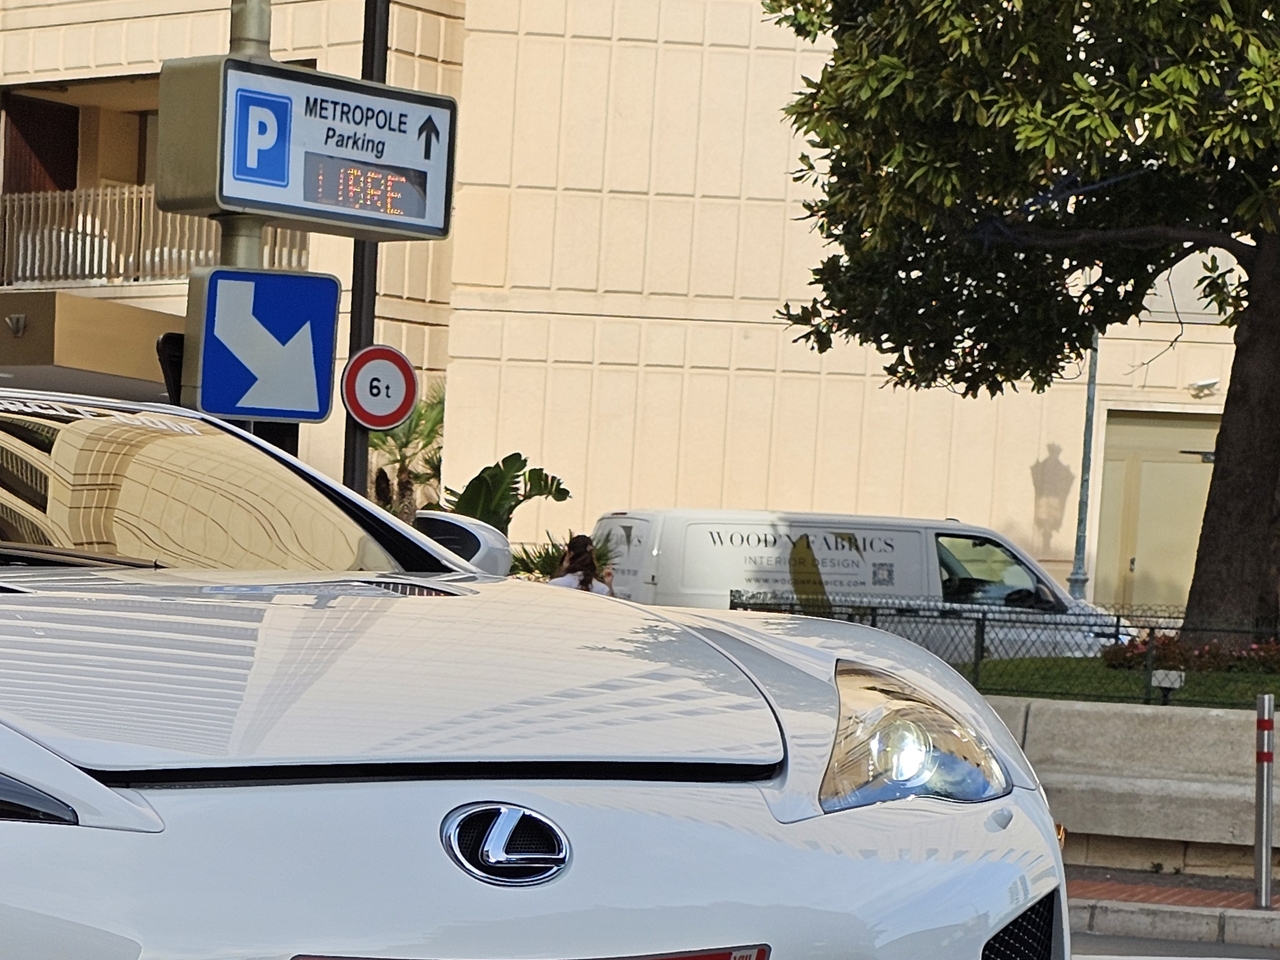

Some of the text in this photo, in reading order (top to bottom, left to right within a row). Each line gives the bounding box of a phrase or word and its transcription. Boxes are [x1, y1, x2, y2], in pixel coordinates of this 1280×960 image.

[304, 96, 408, 134] METROPOLE
[246, 105, 278, 169] P
[324, 127, 386, 159] Parking
[806, 533, 895, 554] FABRICS
[744, 555, 861, 569] INTERIOR DESIGN
